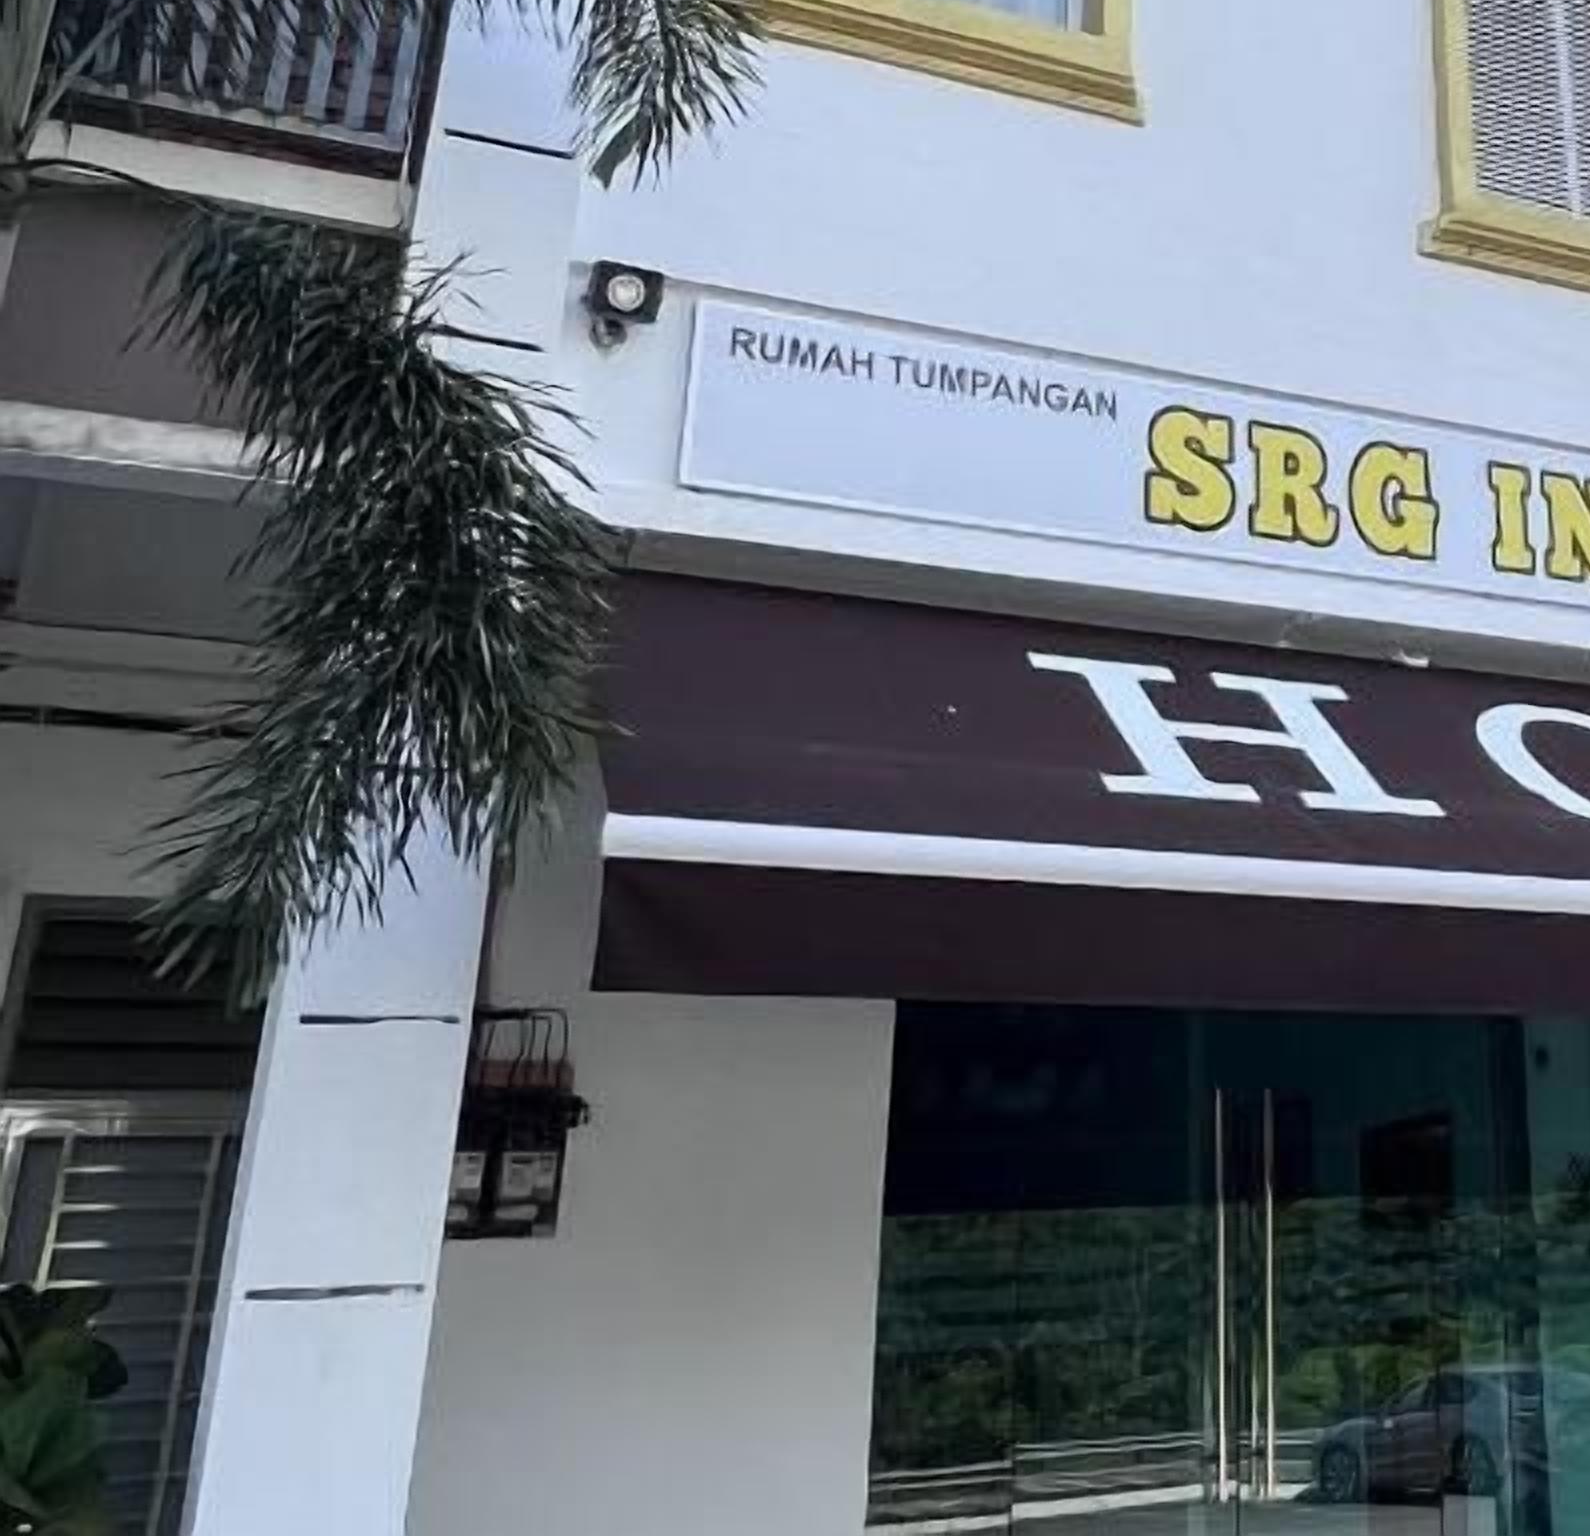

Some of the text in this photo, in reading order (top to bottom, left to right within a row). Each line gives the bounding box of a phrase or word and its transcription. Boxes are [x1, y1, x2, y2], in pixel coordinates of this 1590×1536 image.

[730, 327, 1119, 422] RUMAH TUMPANGAN
[1144, 405, 1440, 561] SRG
